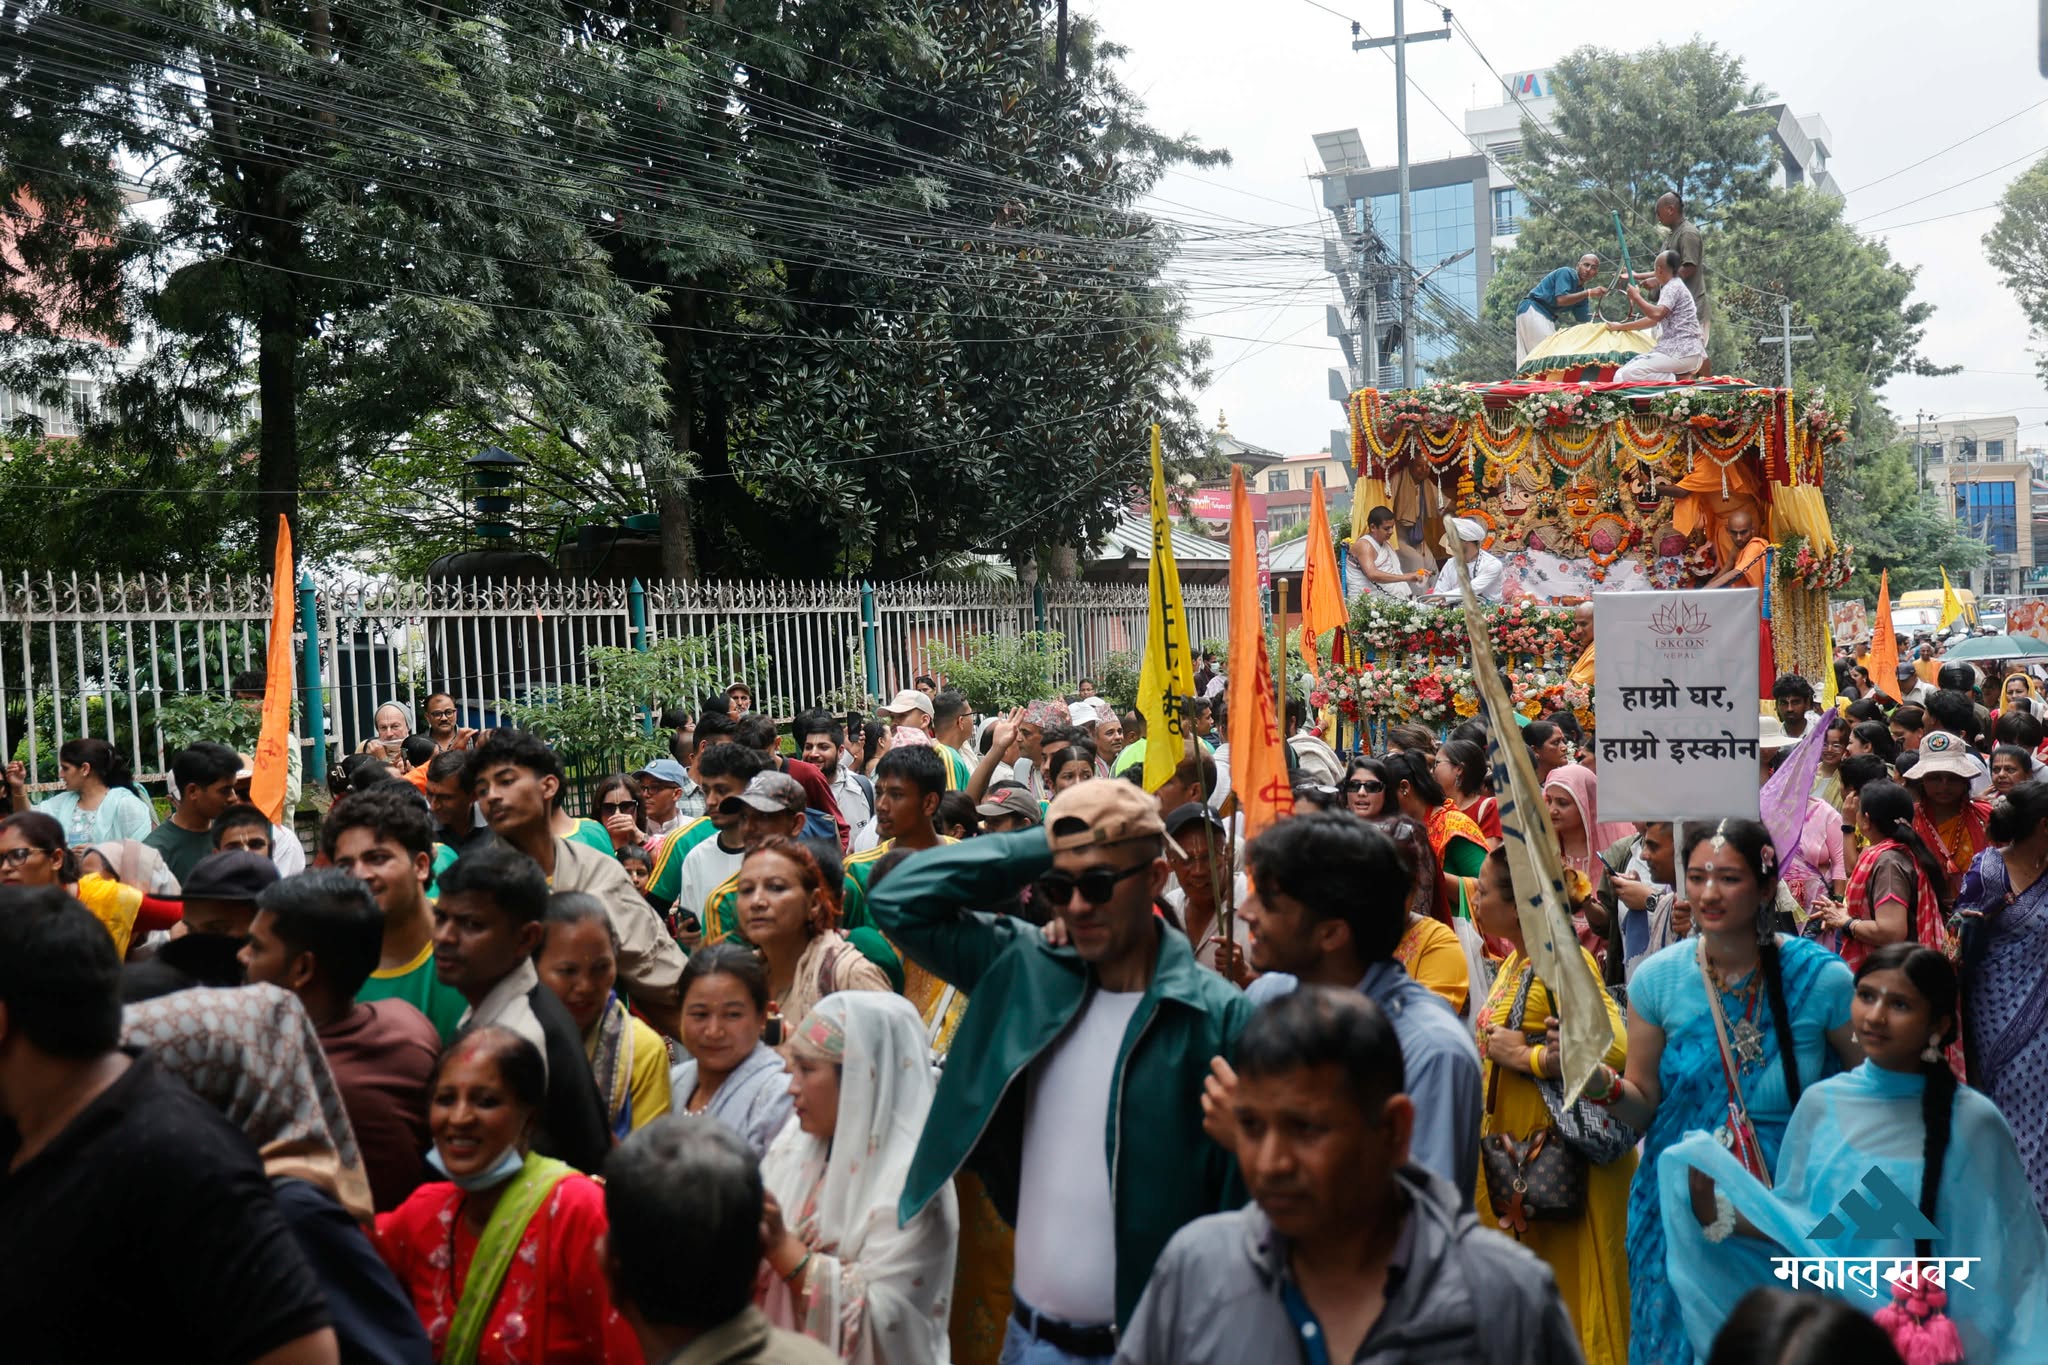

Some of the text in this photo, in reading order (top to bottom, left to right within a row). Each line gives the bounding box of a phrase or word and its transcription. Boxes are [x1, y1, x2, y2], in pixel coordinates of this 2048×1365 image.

[1655, 639, 1704, 648] ISKCON
[1663, 652, 1695, 660] NEPAL
[1618, 678, 1734, 712] हाम्रो घर,
[1599, 730, 1758, 765] हाम्रो इस्कोन
